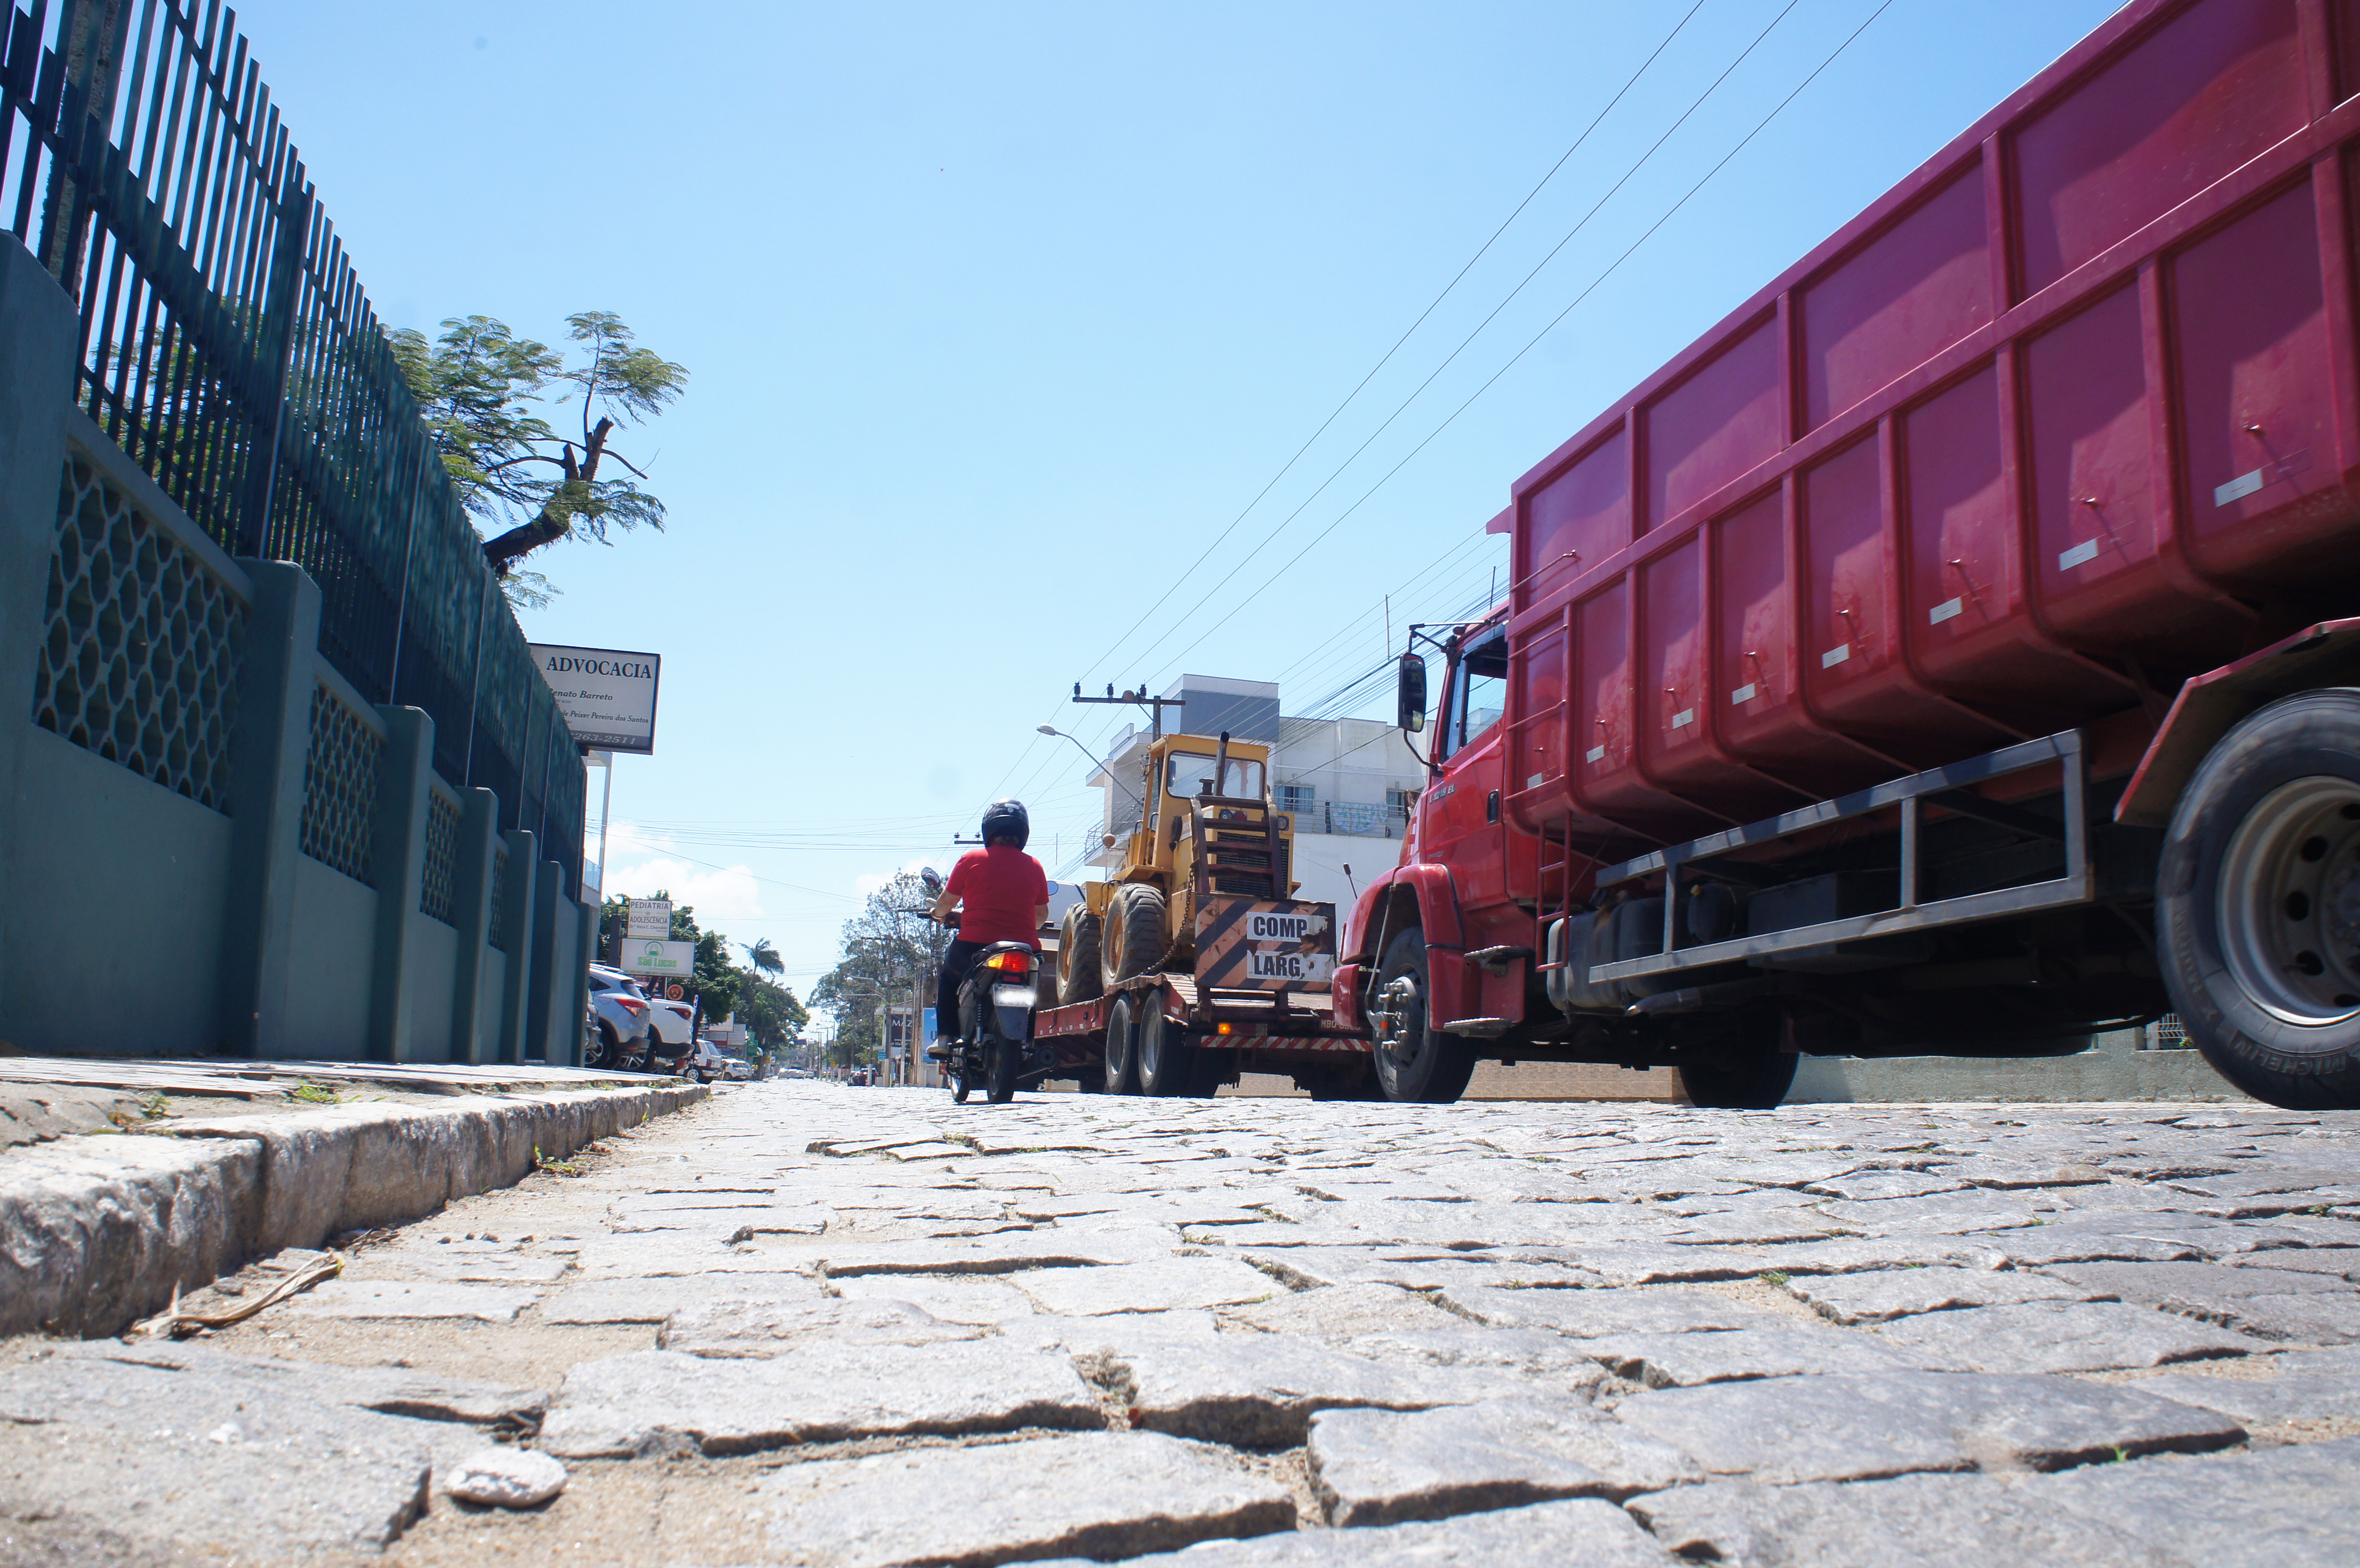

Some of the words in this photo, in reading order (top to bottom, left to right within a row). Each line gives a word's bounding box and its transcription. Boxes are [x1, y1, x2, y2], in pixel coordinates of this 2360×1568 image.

[547, 657, 652, 679] ADVOCACIA
[552, 689, 577, 698] enato
[579, 690, 613, 700] Barreto
[570, 710, 590, 718] Peixer
[591, 712, 613, 721] Pereira
[627, 715, 649, 723] Santos
[572, 733, 637, 744] 263-2511
[630, 902, 669, 910] PEDIATRIA
[630, 915, 668, 924] ADOLESCÊNCIA
[1254, 916, 1307, 938] COMP
[654, 958, 677, 968] Lucas
[2233, 1040, 2347, 1076] MICHELIN
